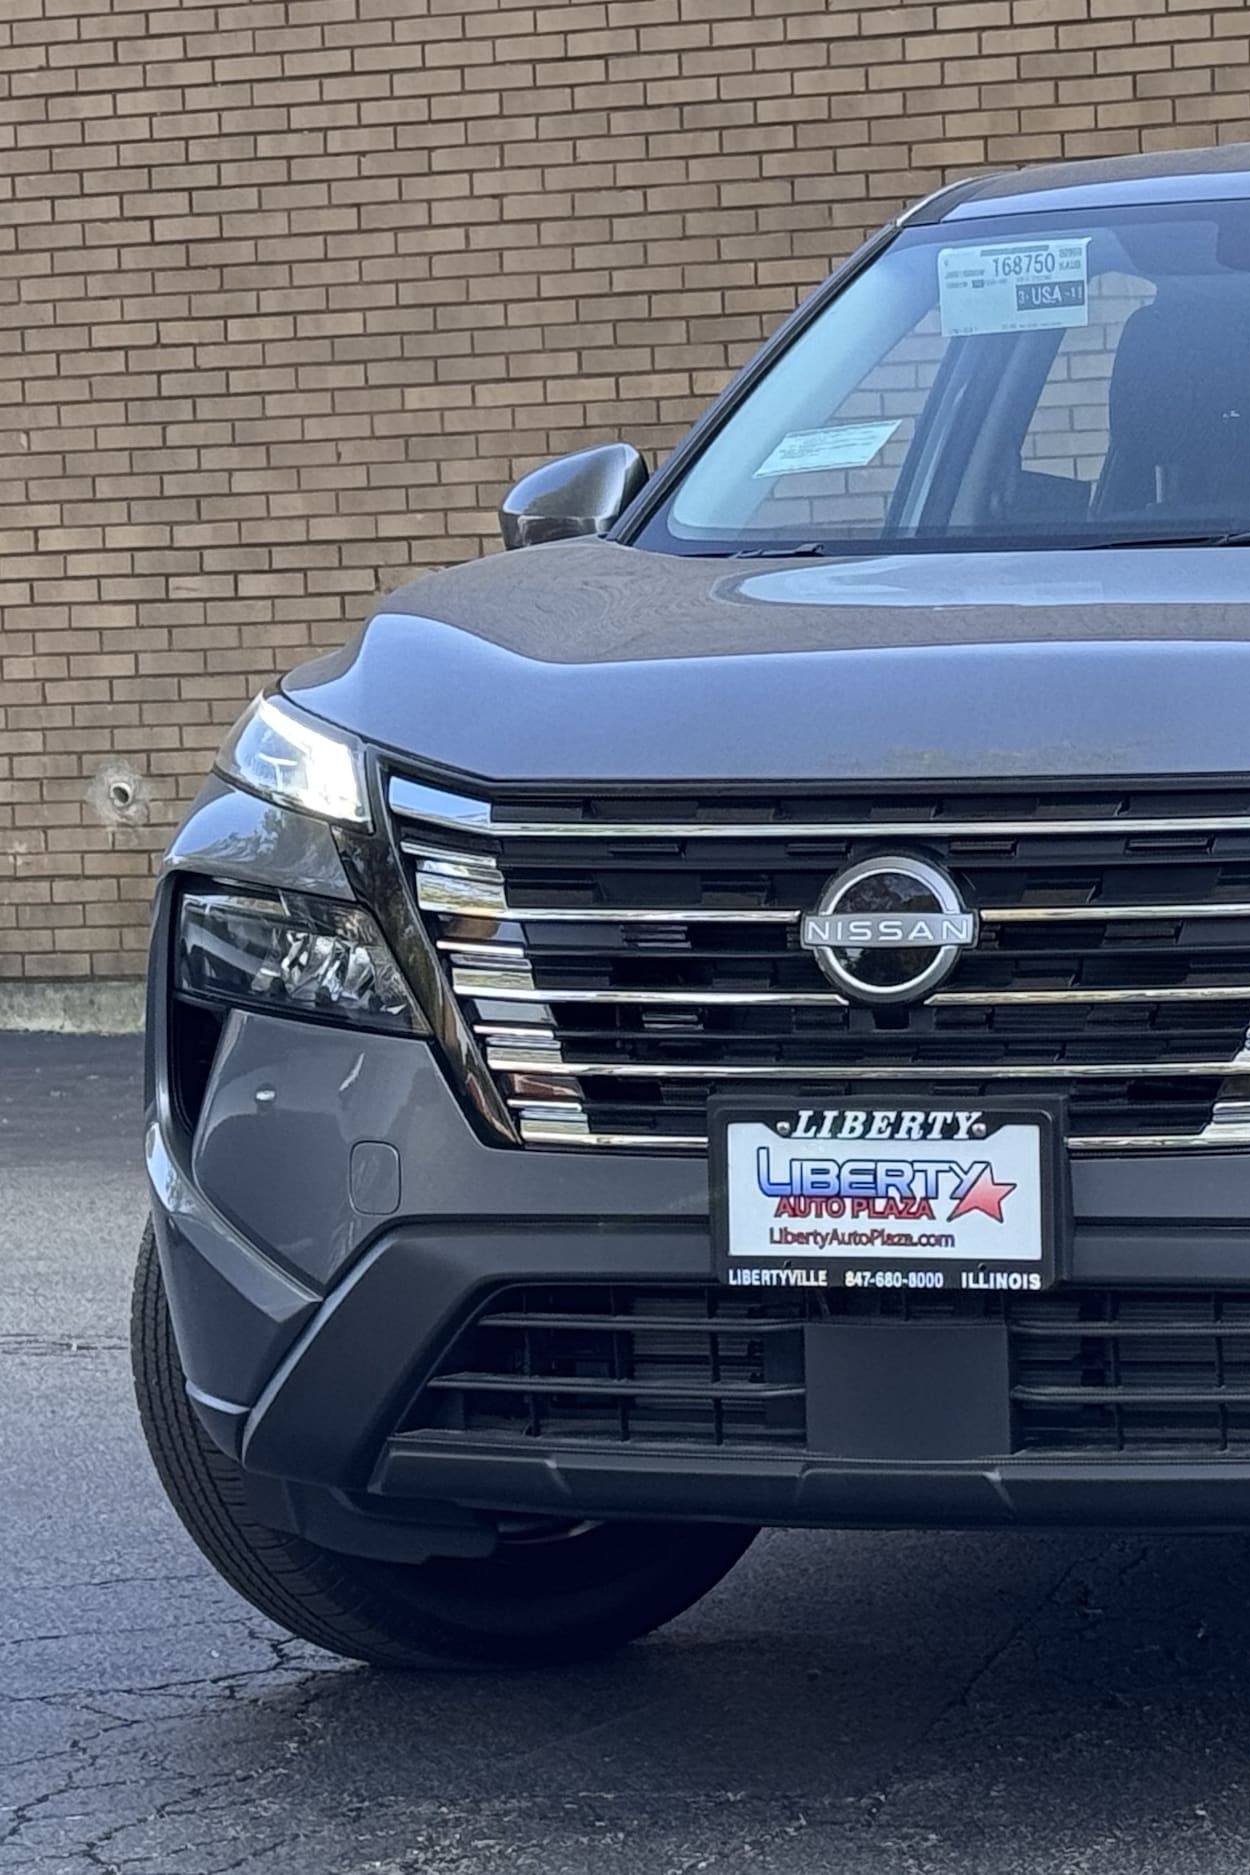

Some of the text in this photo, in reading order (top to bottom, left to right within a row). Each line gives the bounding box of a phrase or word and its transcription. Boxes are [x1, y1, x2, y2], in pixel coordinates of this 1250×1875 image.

[992, 252, 1056, 278] 168750
[1032, 283, 1063, 305] USA
[808, 921, 967, 941] NISSAN
[791, 1110, 983, 1139] LIBERTY
[757, 1146, 990, 1200] LIBERTY
[774, 1196, 936, 1220] AUTO PLAZA
[769, 1227, 956, 1249] LibertyAutoPlaza.com
[728, 1269, 1042, 1290] LIBERTYVILLE 847-680-8000 ILLINOIS
